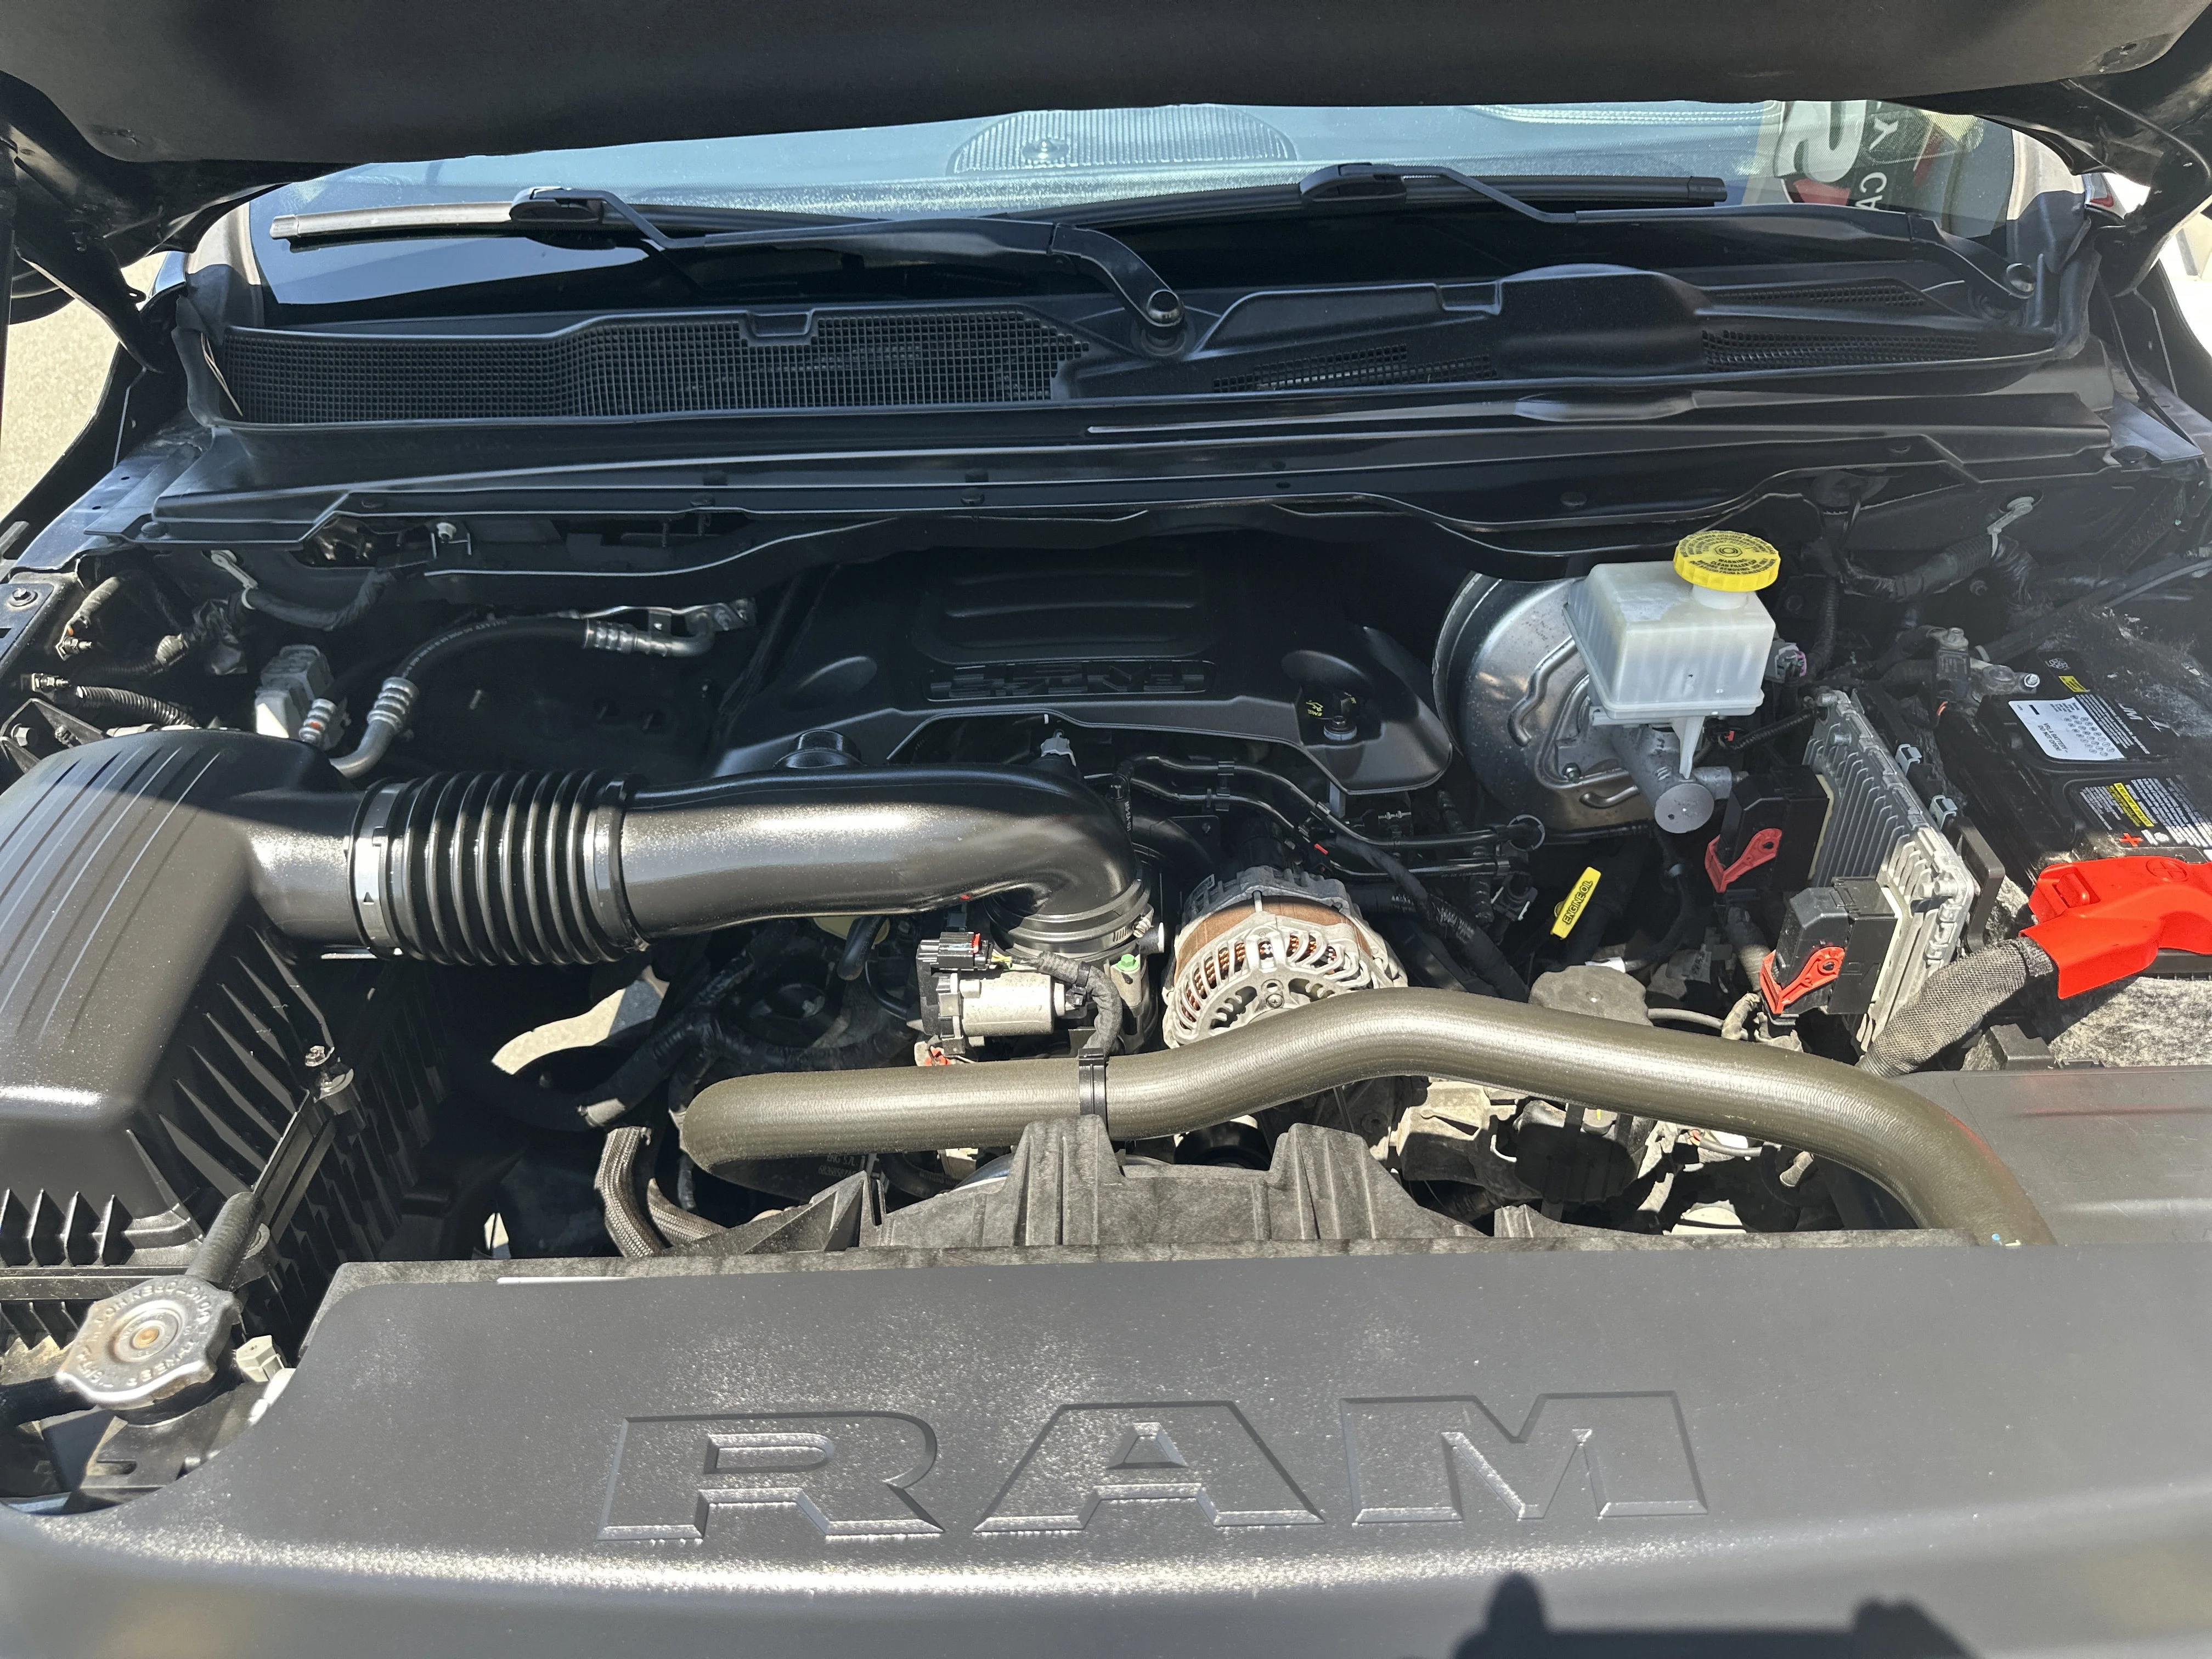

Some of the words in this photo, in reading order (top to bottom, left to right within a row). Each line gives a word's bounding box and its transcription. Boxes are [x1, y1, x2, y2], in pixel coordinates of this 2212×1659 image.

[1562, 892, 1585, 924] ENGINE
[1579, 881, 1593, 894] OIL
[597, 1390, 1708, 1543] RAM
